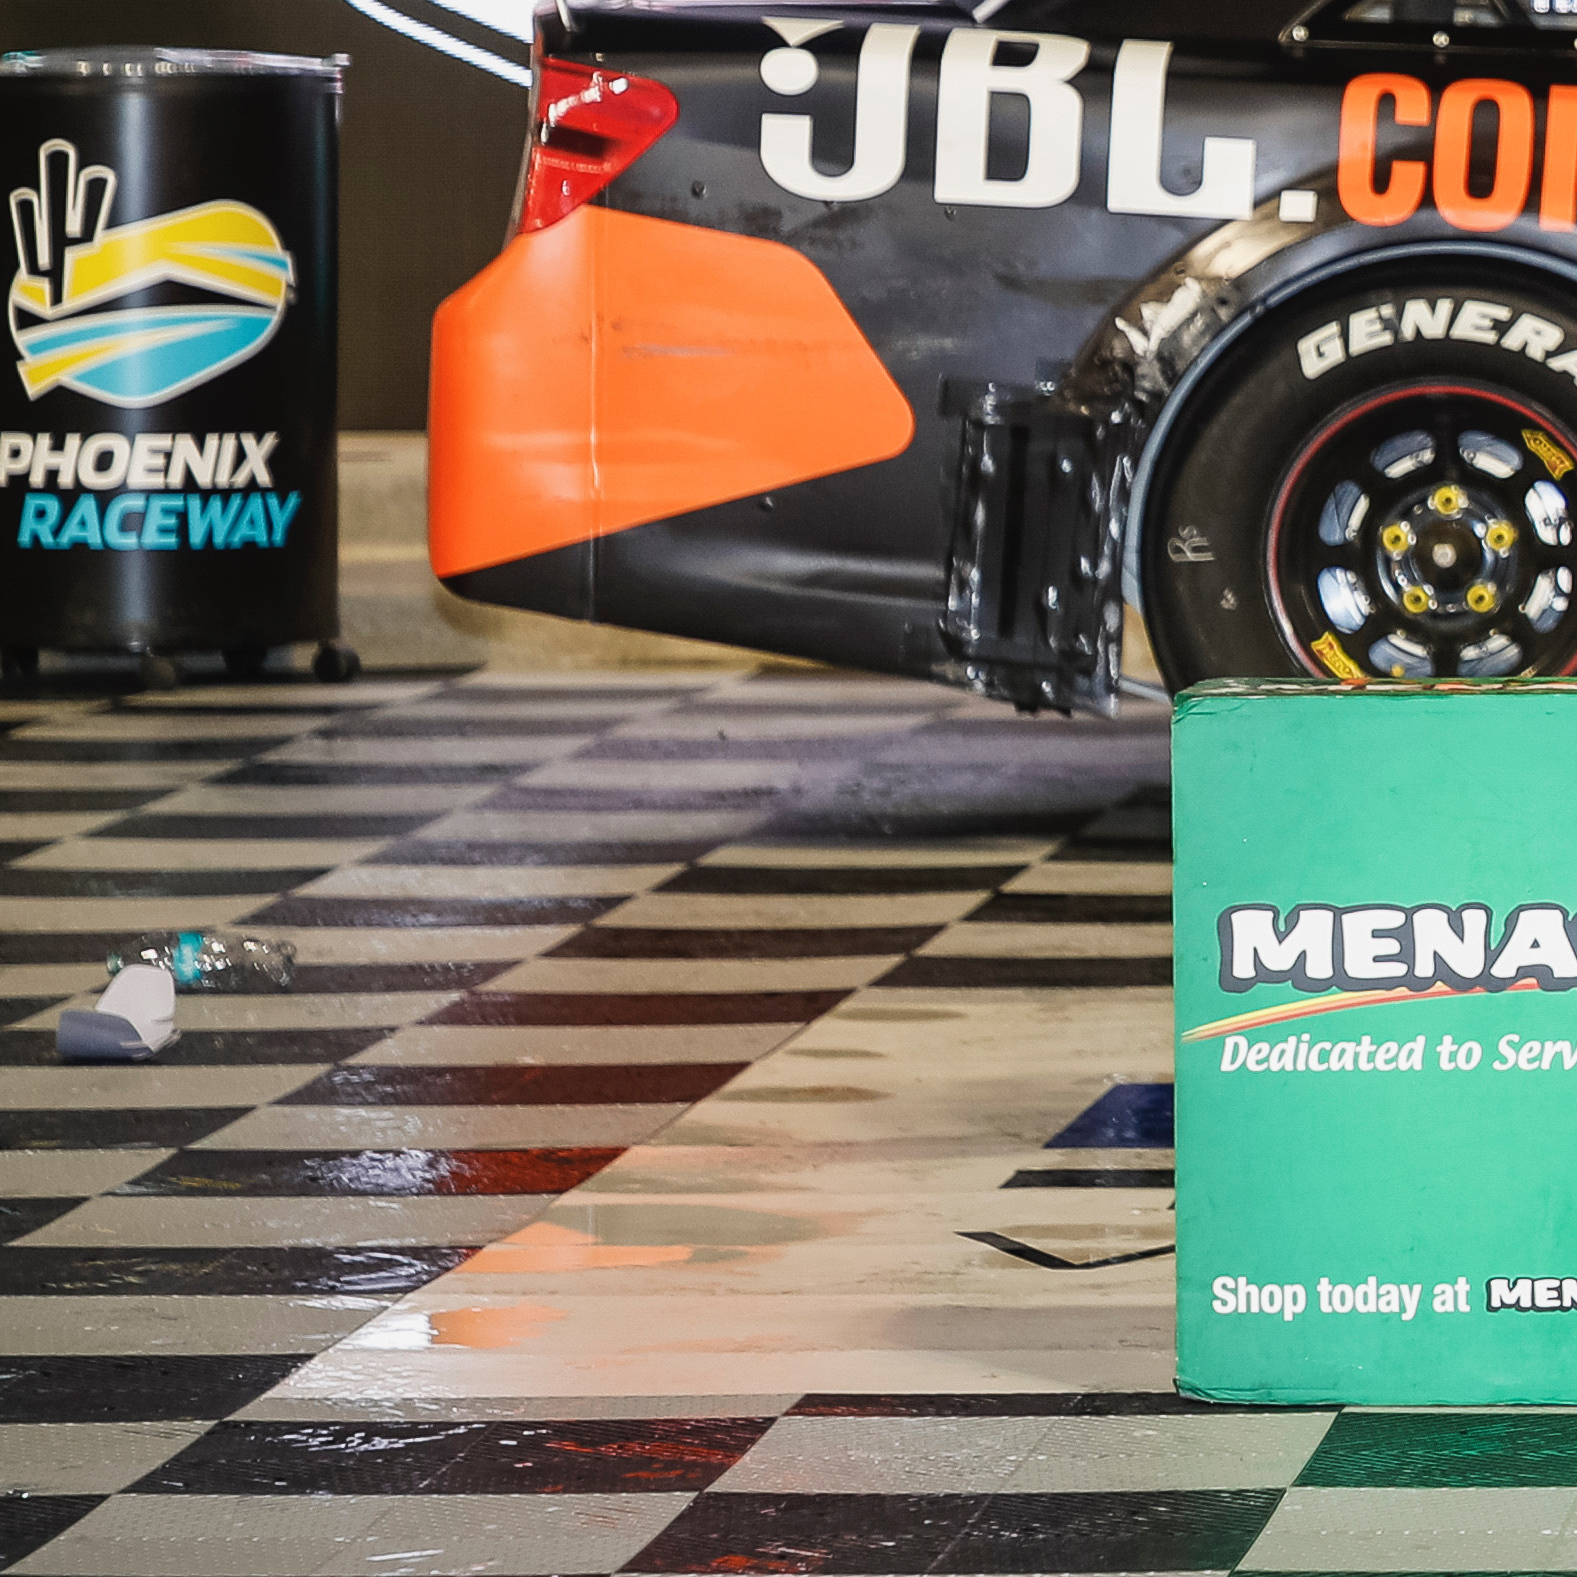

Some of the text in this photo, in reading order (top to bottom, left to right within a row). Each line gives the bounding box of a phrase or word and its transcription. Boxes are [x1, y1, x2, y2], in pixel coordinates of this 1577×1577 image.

[0, 431, 280, 490] PHOENIX
[16, 490, 302, 551] RACEWAY
[1219, 1031, 1427, 1073] Dedicated
[1436, 1034, 1482, 1072] to
[1211, 1275, 1305, 1322] Shop
[1316, 1274, 1423, 1322] today
[1432, 1277, 1471, 1315] at
